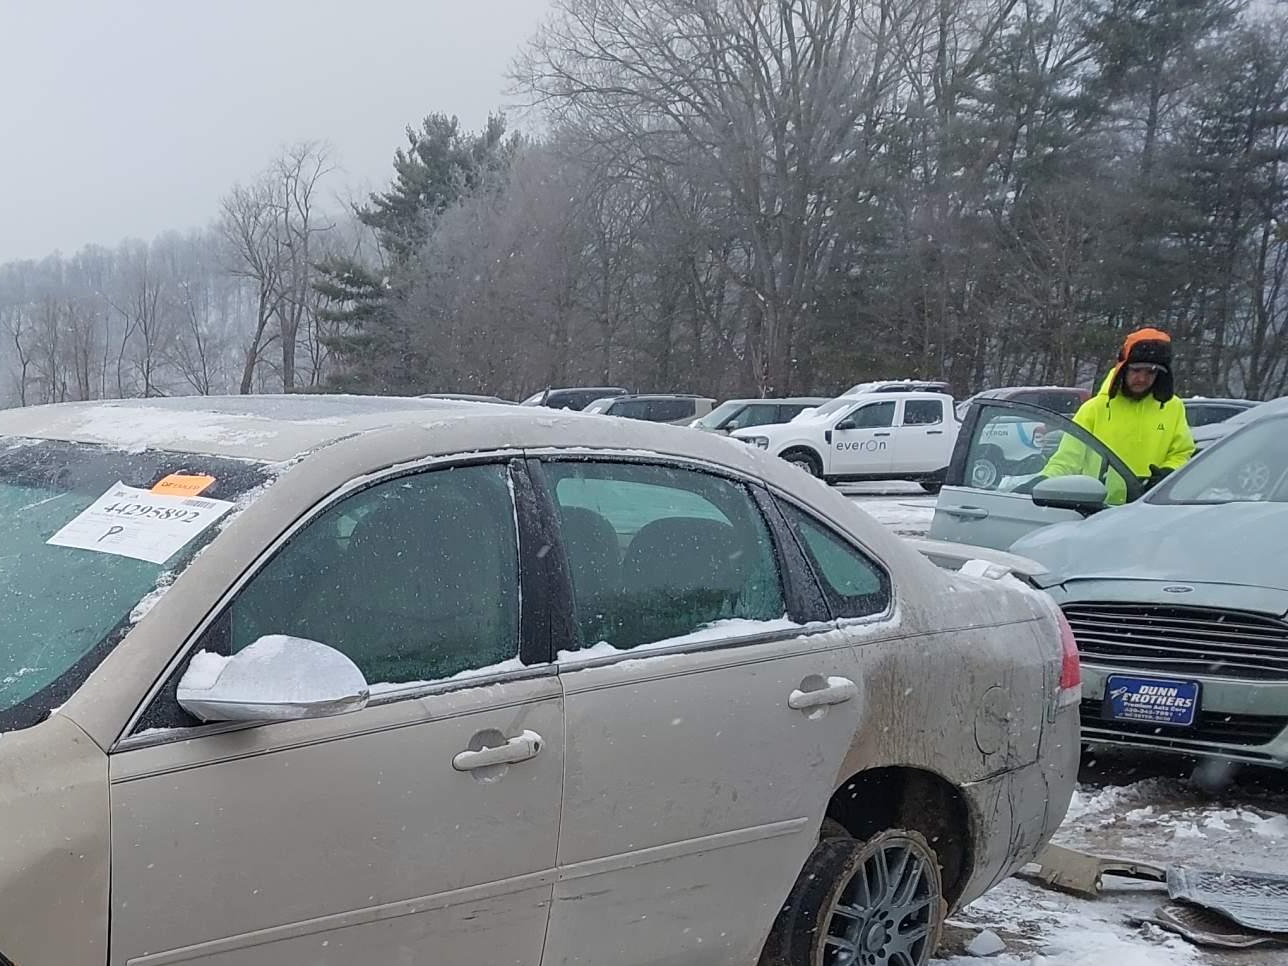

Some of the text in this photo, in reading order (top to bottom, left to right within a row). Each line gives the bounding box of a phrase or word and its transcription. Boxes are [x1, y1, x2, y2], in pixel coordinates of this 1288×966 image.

[104, 502, 200, 523] 44295892
[97, 525, 124, 543] P
[1138, 685, 1178, 696] DUNN
[1122, 693, 1192, 707] BROTHERS
